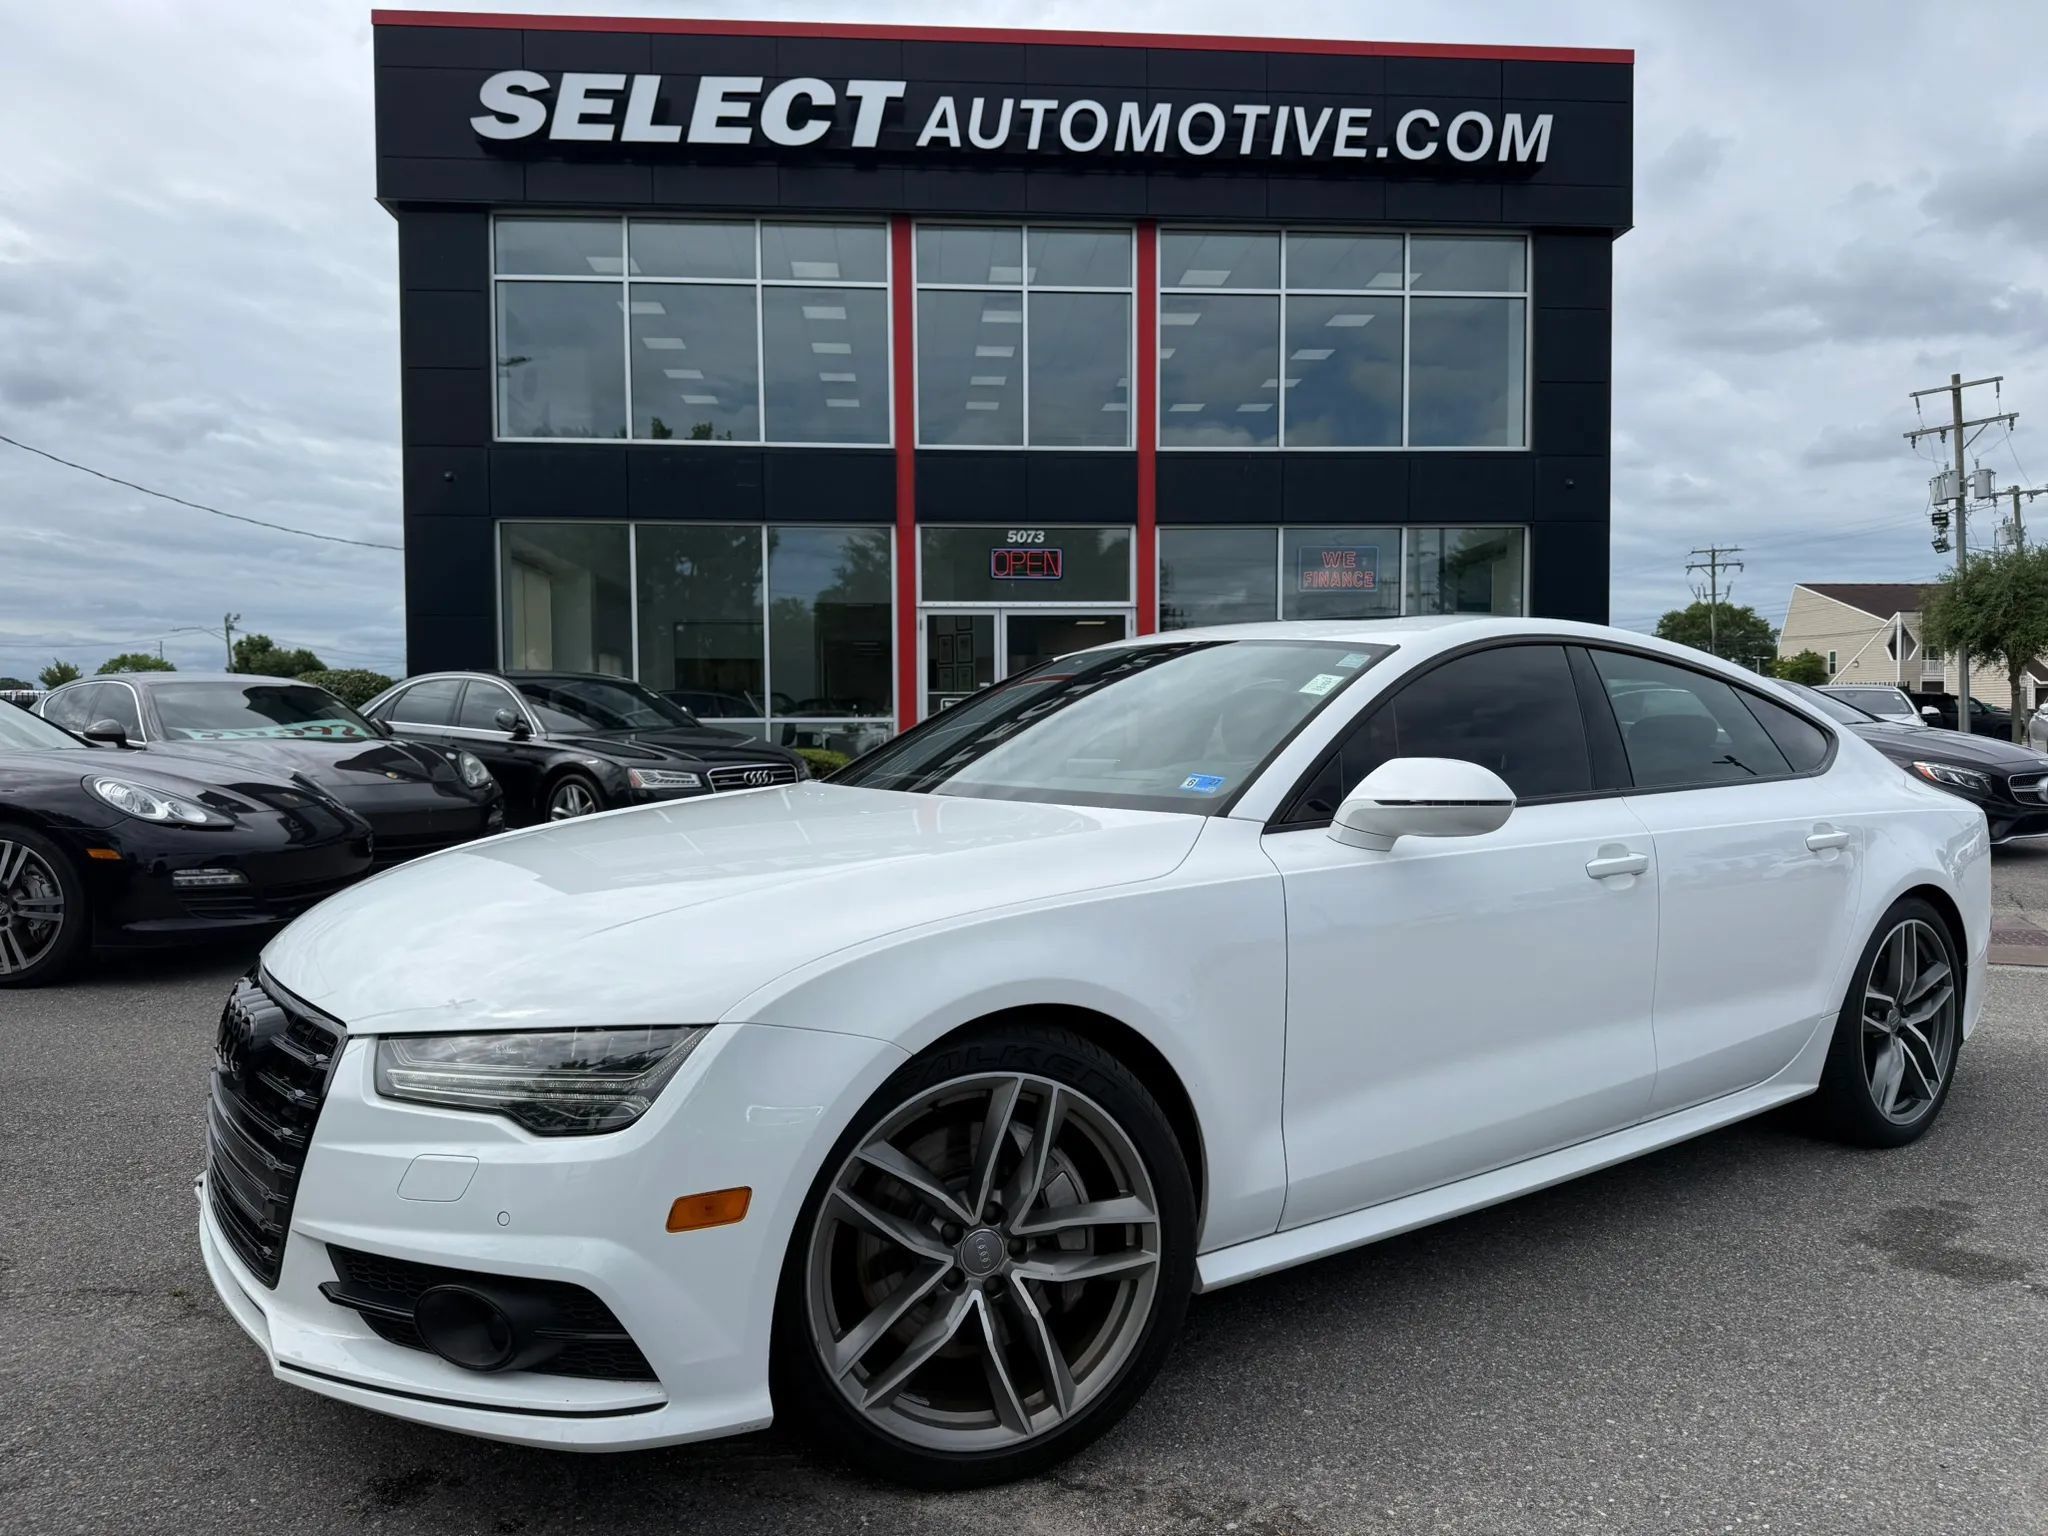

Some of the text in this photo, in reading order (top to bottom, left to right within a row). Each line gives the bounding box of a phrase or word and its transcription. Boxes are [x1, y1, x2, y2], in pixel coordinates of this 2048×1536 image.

[469, 70, 1553, 163] SELECT AUTOMOTIVE.COM
[1006, 530, 1045, 543] 5073
[993, 550, 1061, 577] OPEN
[1321, 551, 1356, 569] WE
[1303, 571, 1374, 588] FINANCE
